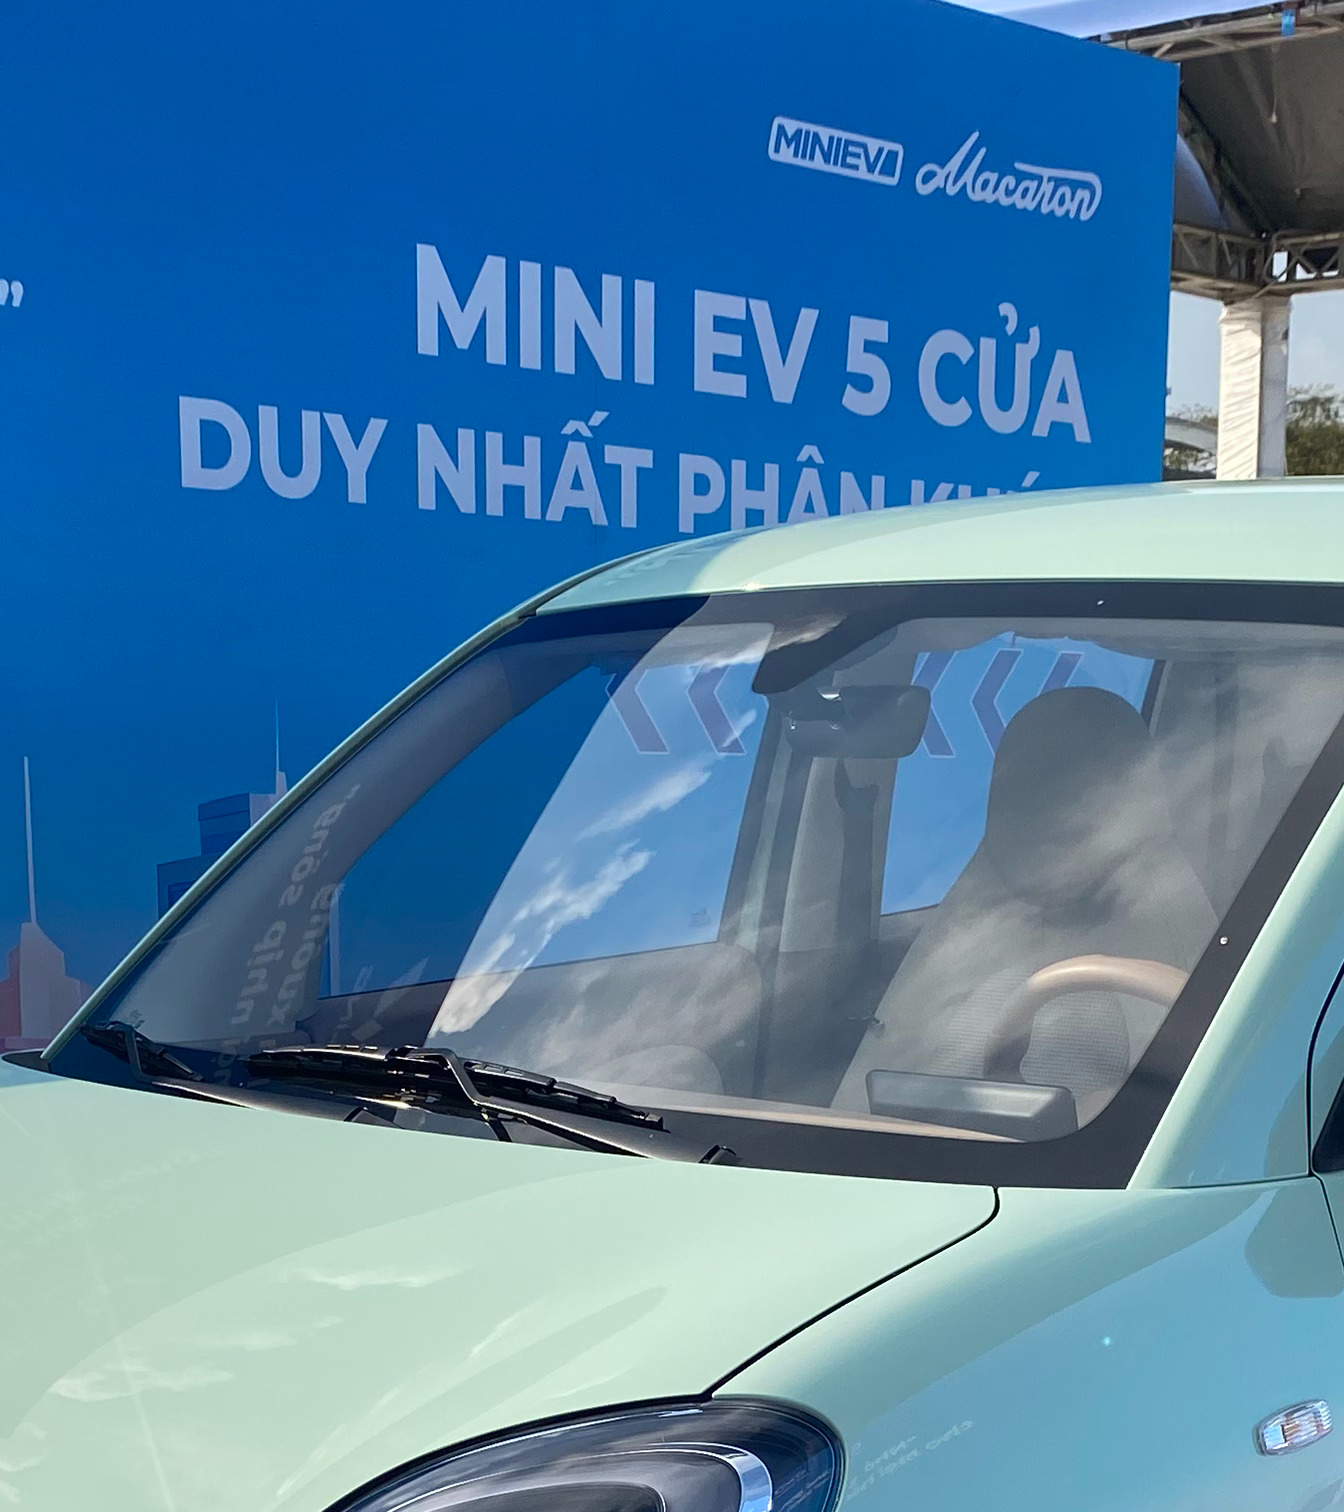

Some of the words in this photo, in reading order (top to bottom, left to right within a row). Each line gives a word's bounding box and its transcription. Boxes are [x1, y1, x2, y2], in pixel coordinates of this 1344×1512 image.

[915, 131, 1103, 221] Macaron
[416, 243, 655, 385] MINI
[693, 289, 820, 404] EV
[841, 315, 891, 417] 5
[918, 302, 1092, 443] CỬA
[178, 395, 388, 504] DUY
[417, 410, 654, 528] NHẤT
